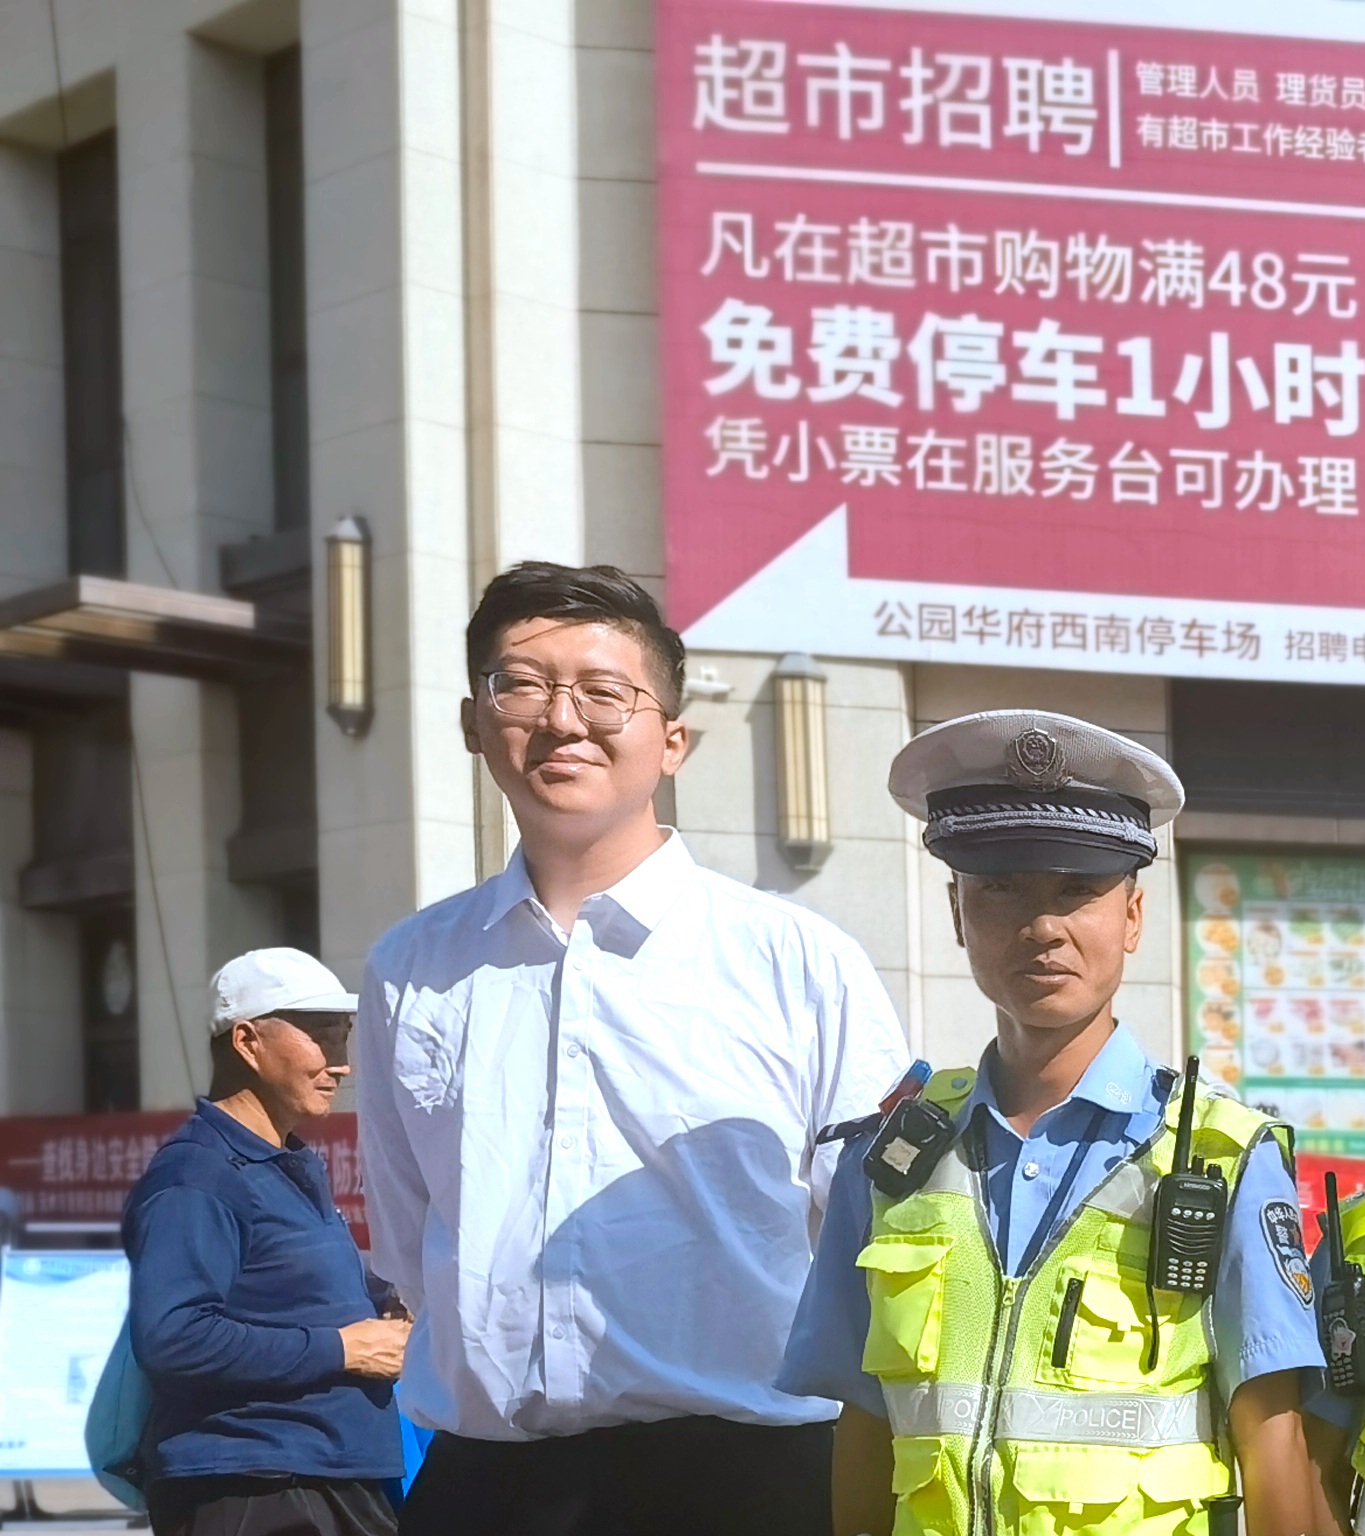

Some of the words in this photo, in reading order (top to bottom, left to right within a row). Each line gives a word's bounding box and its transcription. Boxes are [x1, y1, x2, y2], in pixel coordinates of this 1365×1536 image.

[693, 33, 1098, 156] 超市招聘
[1135, 61, 1260, 102] 管理人员
[700, 211, 1359, 320] 凡在超市购物满48元
[704, 416, 1361, 516] 凭小票在服务台可办理
[874, 601, 1262, 661] 公园华府西南停车场
[1060, 1408, 1136, 1430] POLICE
